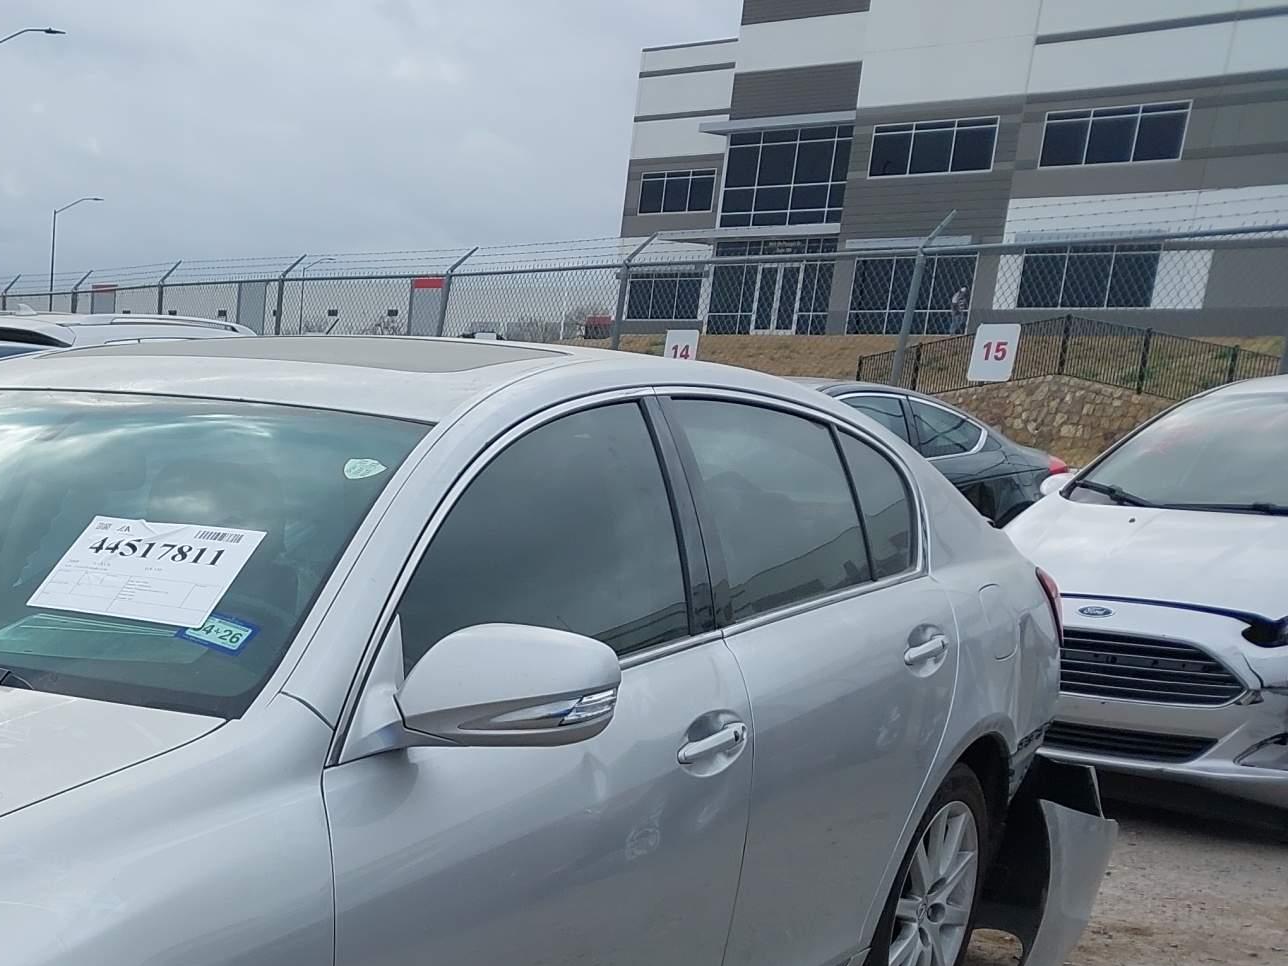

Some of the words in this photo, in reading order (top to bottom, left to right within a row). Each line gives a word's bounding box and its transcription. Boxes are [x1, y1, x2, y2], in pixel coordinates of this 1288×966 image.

[672, 344, 690, 360] 14
[983, 341, 1009, 361] 15
[89, 536, 225, 566] 44517811
